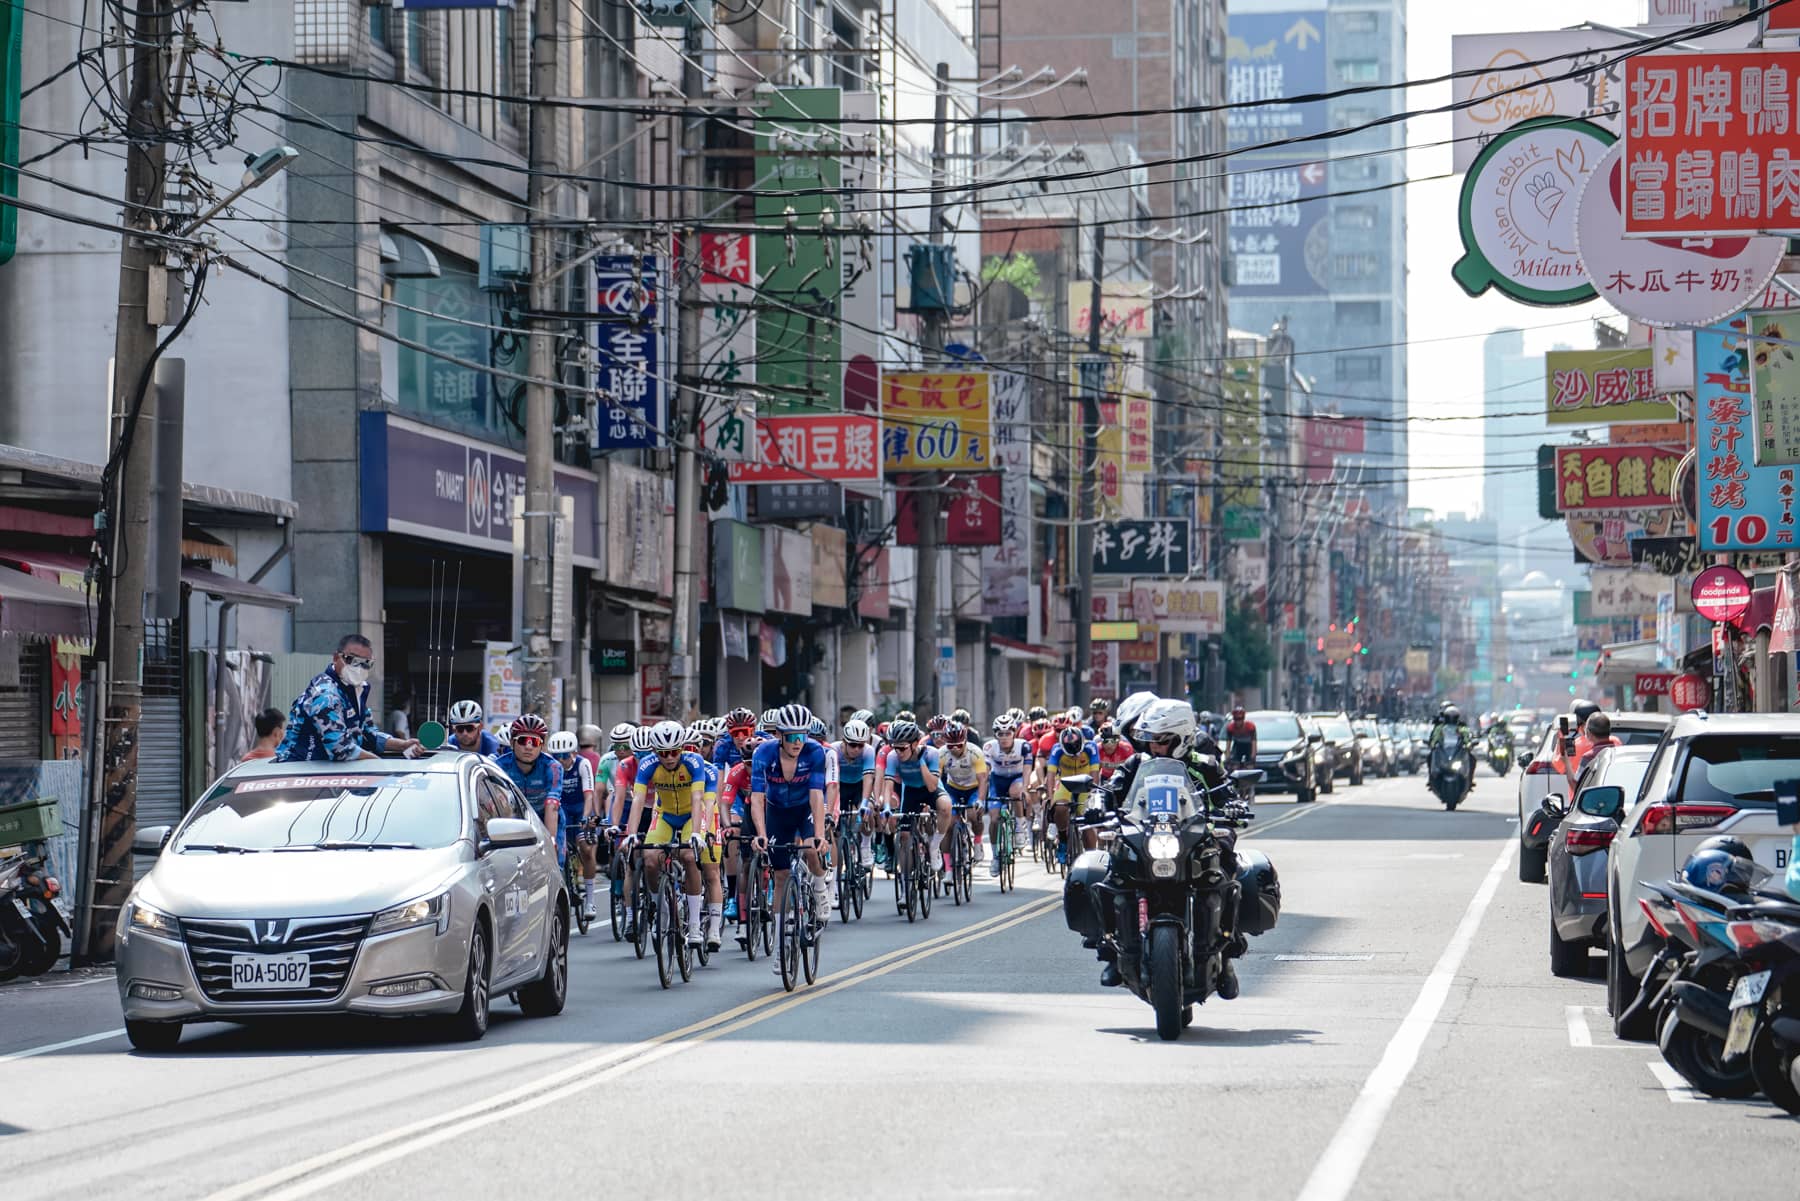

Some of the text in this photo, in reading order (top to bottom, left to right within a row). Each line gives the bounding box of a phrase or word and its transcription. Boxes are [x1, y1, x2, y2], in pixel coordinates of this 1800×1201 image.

[1630, 63, 1800, 138] 招牌鴨
[1630, 147, 1800, 221] 當歸鴨肉
[1512, 256, 1571, 277] Milan
[1605, 268, 1741, 294] 木瓜牛奶
[1708, 515, 1769, 545] 10
[243, 777, 367, 791] Race Director
[233, 962, 307, 983] RDA-5087
